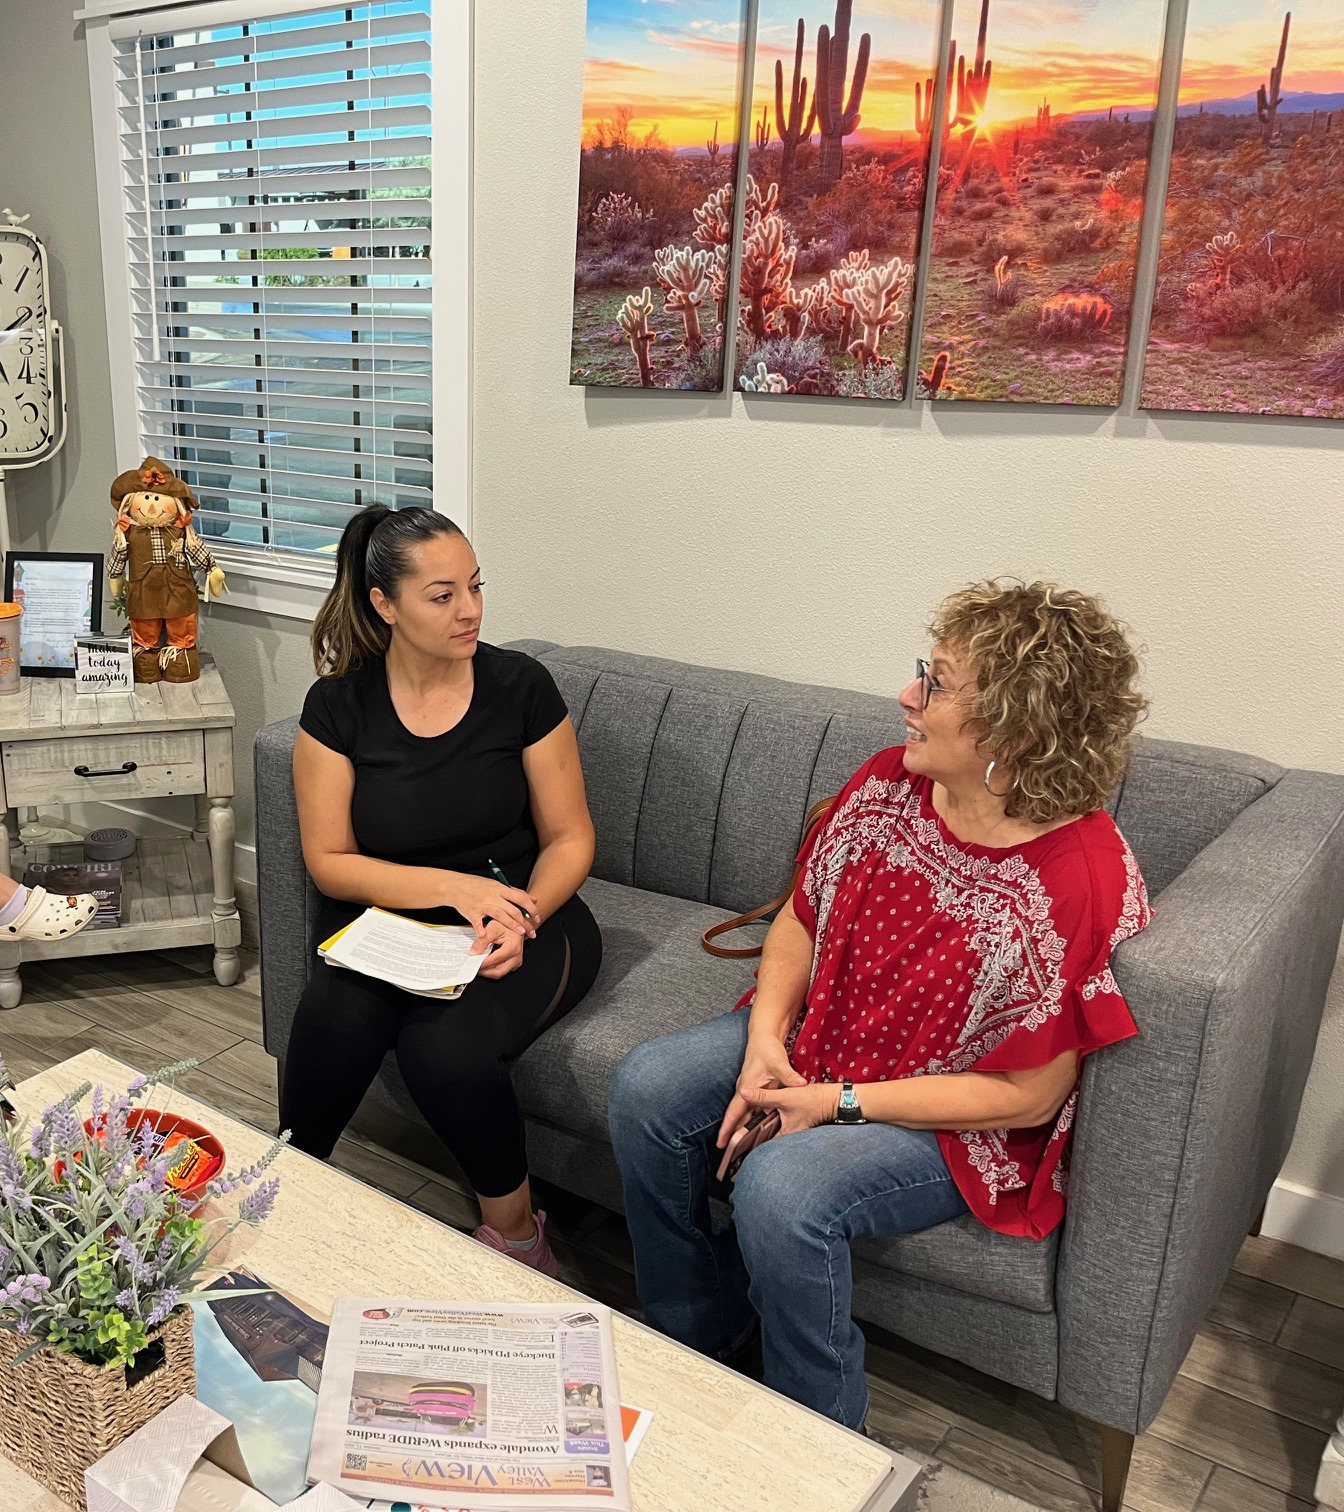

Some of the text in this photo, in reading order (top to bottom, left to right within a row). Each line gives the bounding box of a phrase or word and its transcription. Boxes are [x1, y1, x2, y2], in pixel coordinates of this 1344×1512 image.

[14, 265, 33, 294] 1
[19, 337, 34, 355] 3
[17, 356, 38, 385] 4
[15, 392, 39, 425] 5
[88, 656, 120, 672] today
[82, 672, 128, 687] amazing
[30, 863, 118, 873] COIRL
[359, 1340, 556, 1360] Buckeye PD kicks off Pink Patch Project
[346, 1429, 560, 1454] Avondale expands WeRIDE radius
